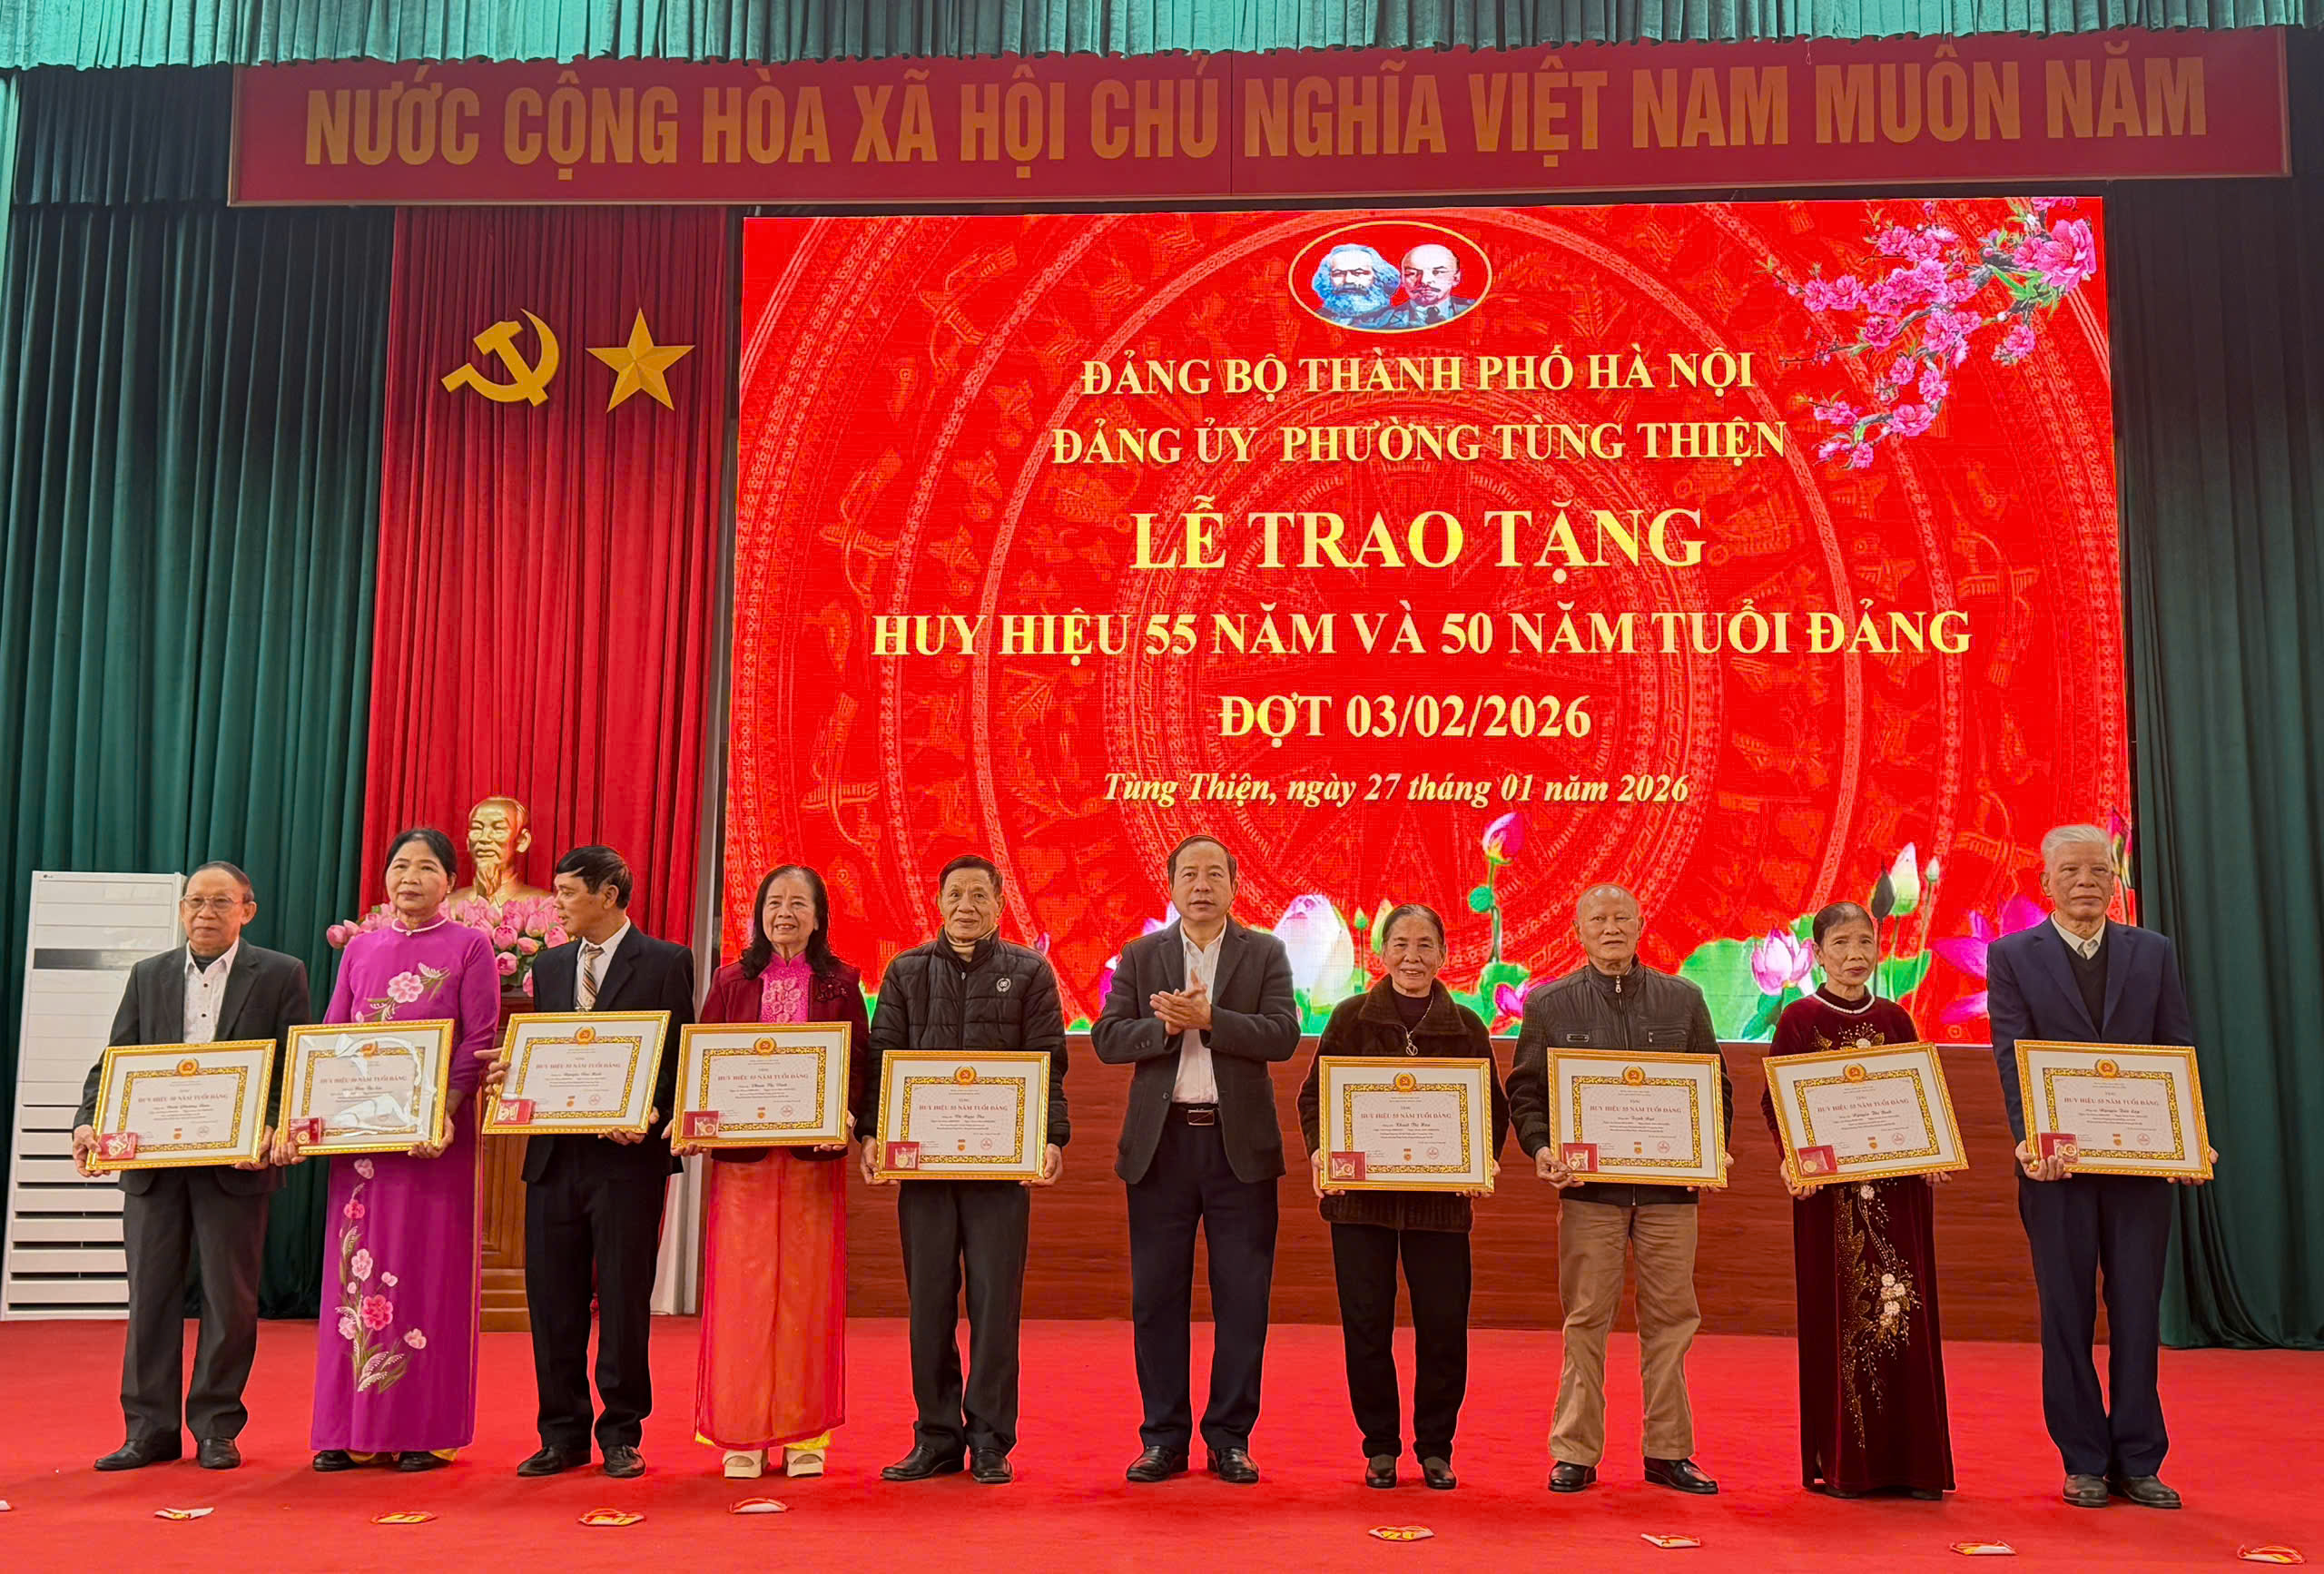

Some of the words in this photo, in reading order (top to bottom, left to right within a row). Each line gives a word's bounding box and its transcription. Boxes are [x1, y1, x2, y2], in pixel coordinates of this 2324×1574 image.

[304, 64, 480, 166] NƯỚC
[504, 69, 678, 182] CỘNG
[702, 67, 832, 165] HÒA
[851, 67, 939, 162] XÃ
[960, 64, 1067, 179] HỘI
[1090, 52, 1220, 160] CHỦ
[1244, 58, 1448, 158] NGHĨA
[1467, 54, 1609, 168] VIỆT
[1631, 64, 1789, 149] NAM
[1815, 43, 2022, 144] MUÔN
[2044, 39, 2208, 139] NĂM
[1080, 349, 1211, 395] ĐẢNG
[1224, 353, 1287, 402] BỘ
[1298, 347, 1463, 392] THÀNH
[1476, 344, 1573, 390] PHỐ
[1588, 342, 1655, 389] HÀ
[1668, 347, 1755, 398] NỘI
[1051, 418, 1182, 464] ĐẢNG
[1194, 417, 1259, 463] ỦY
[1279, 416, 1482, 462] PHƯỜNG
[1492, 414, 1625, 460] TÙNG
[1637, 416, 1787, 467] THIỆN
[1129, 495, 1226, 569] LỄ
[1247, 510, 1463, 568] TRAO
[1484, 499, 1706, 584] TẶNG
[872, 615, 988, 655] HUY
[999, 607, 1131, 666] HIỆU
[1145, 614, 1197, 655] 55
[1211, 602, 1335, 654] NĂM
[1351, 600, 1426, 654] VÀ
[1442, 612, 1493, 654] 50
[1508, 601, 1637, 654] NĂM
[1651, 598, 1789, 654] TUỔI
[1806, 598, 1971, 654] ĐẢNG
[1217, 692, 1332, 748] ĐỢT
[1346, 694, 1591, 738] 03/02/2026
[1103, 772, 1179, 808] Tùng
[1188, 772, 1277, 808] Thiện,
[1286, 772, 1357, 808] ngày
[1364, 772, 1403, 801] 27
[1408, 772, 1492, 809] tháng
[1501, 773, 1534, 802] 01
[1544, 774, 1609, 802] năm
[1617, 774, 1689, 802] 2026
